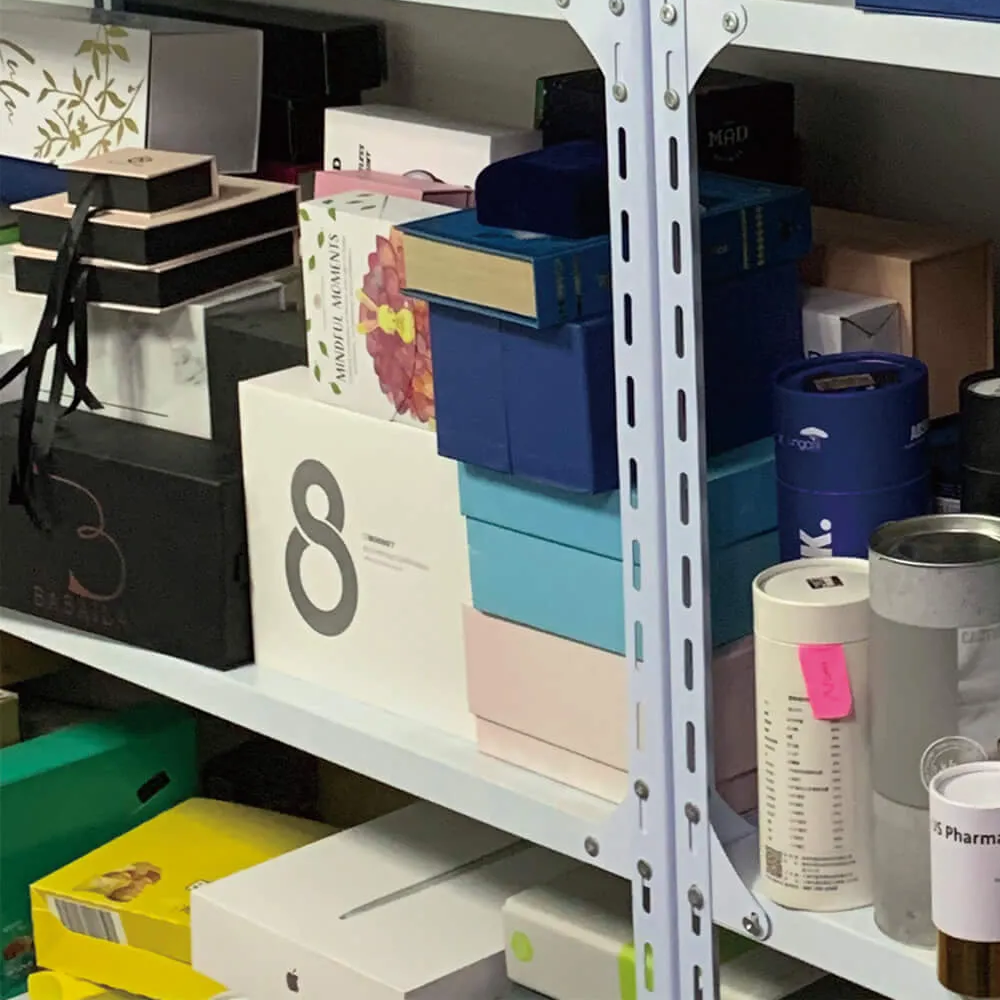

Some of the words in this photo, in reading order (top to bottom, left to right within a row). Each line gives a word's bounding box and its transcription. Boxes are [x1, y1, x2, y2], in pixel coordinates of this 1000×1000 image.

[328, 232, 344, 310] MOMENTS
[332, 314, 347, 383] MINDFUL
[285, 459, 359, 638] 8
